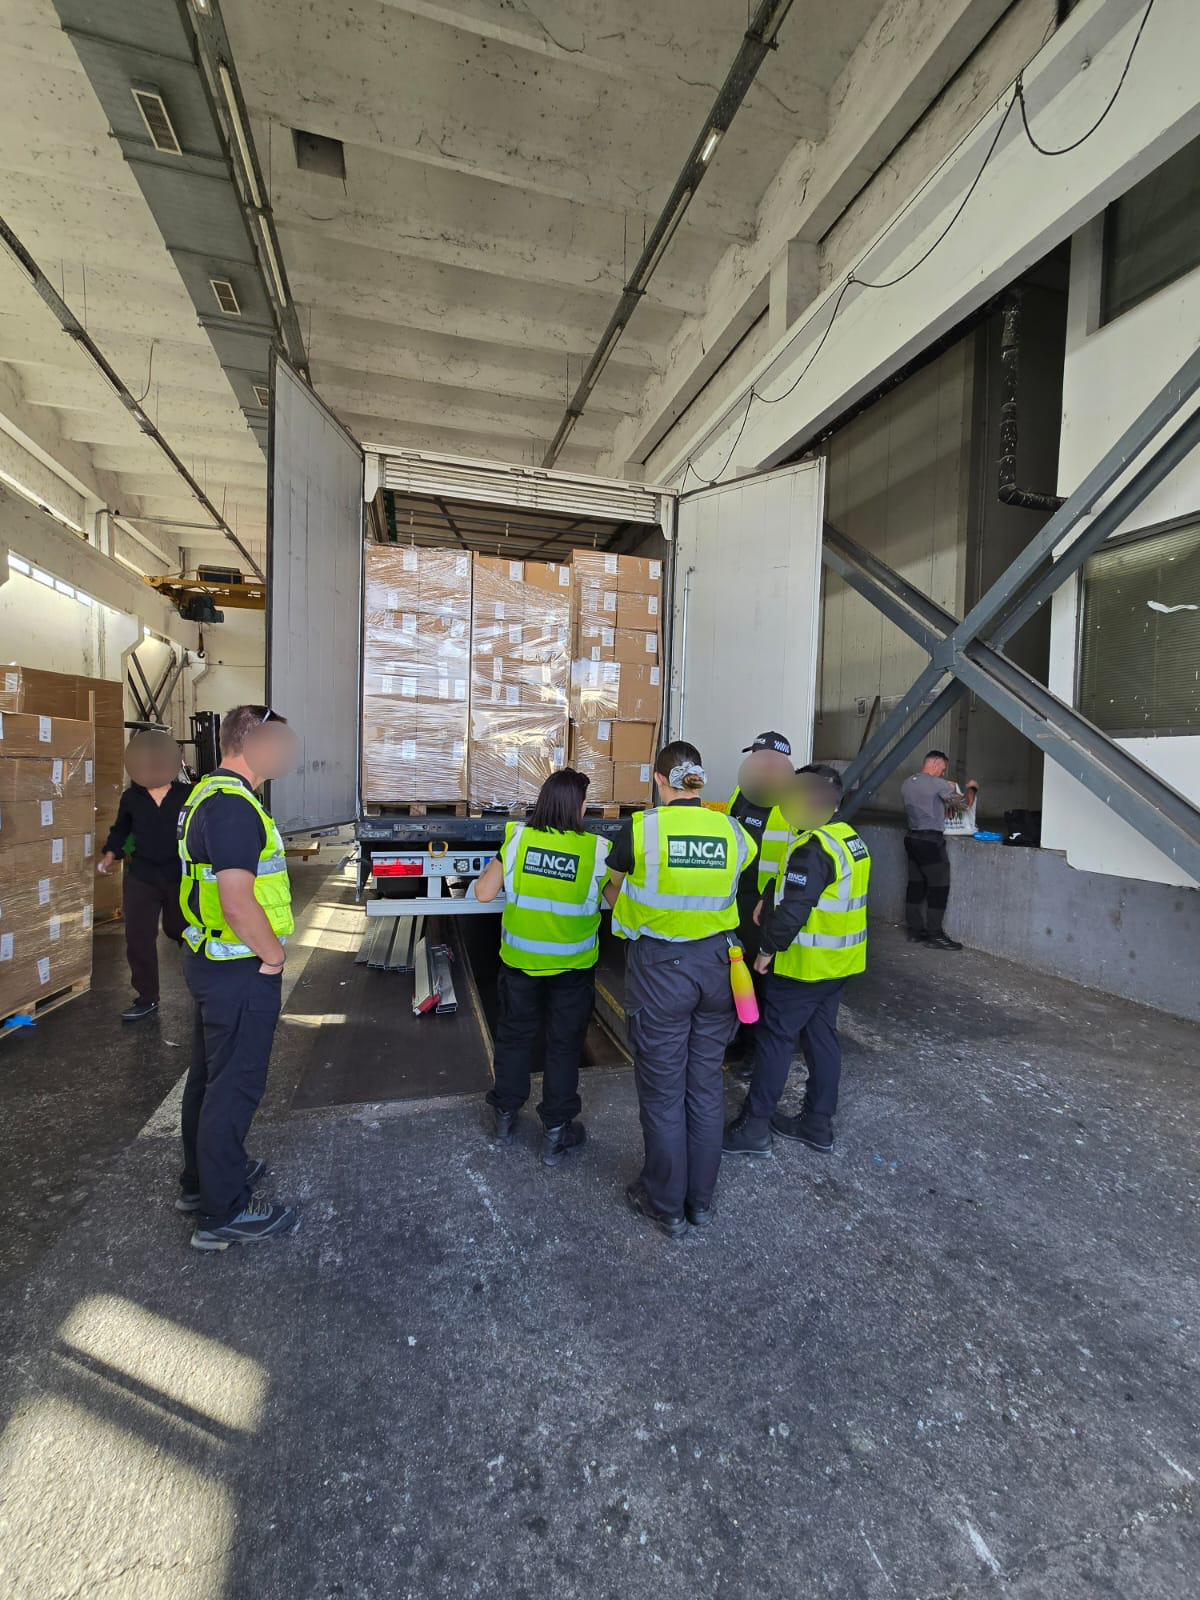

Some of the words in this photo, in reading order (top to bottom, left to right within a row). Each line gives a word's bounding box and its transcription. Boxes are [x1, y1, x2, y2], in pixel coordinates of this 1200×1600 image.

[689, 841, 726, 859] NCA
[542, 854, 577, 873] NCA
[669, 856, 690, 865] National
[706, 859, 725, 867] Agency
